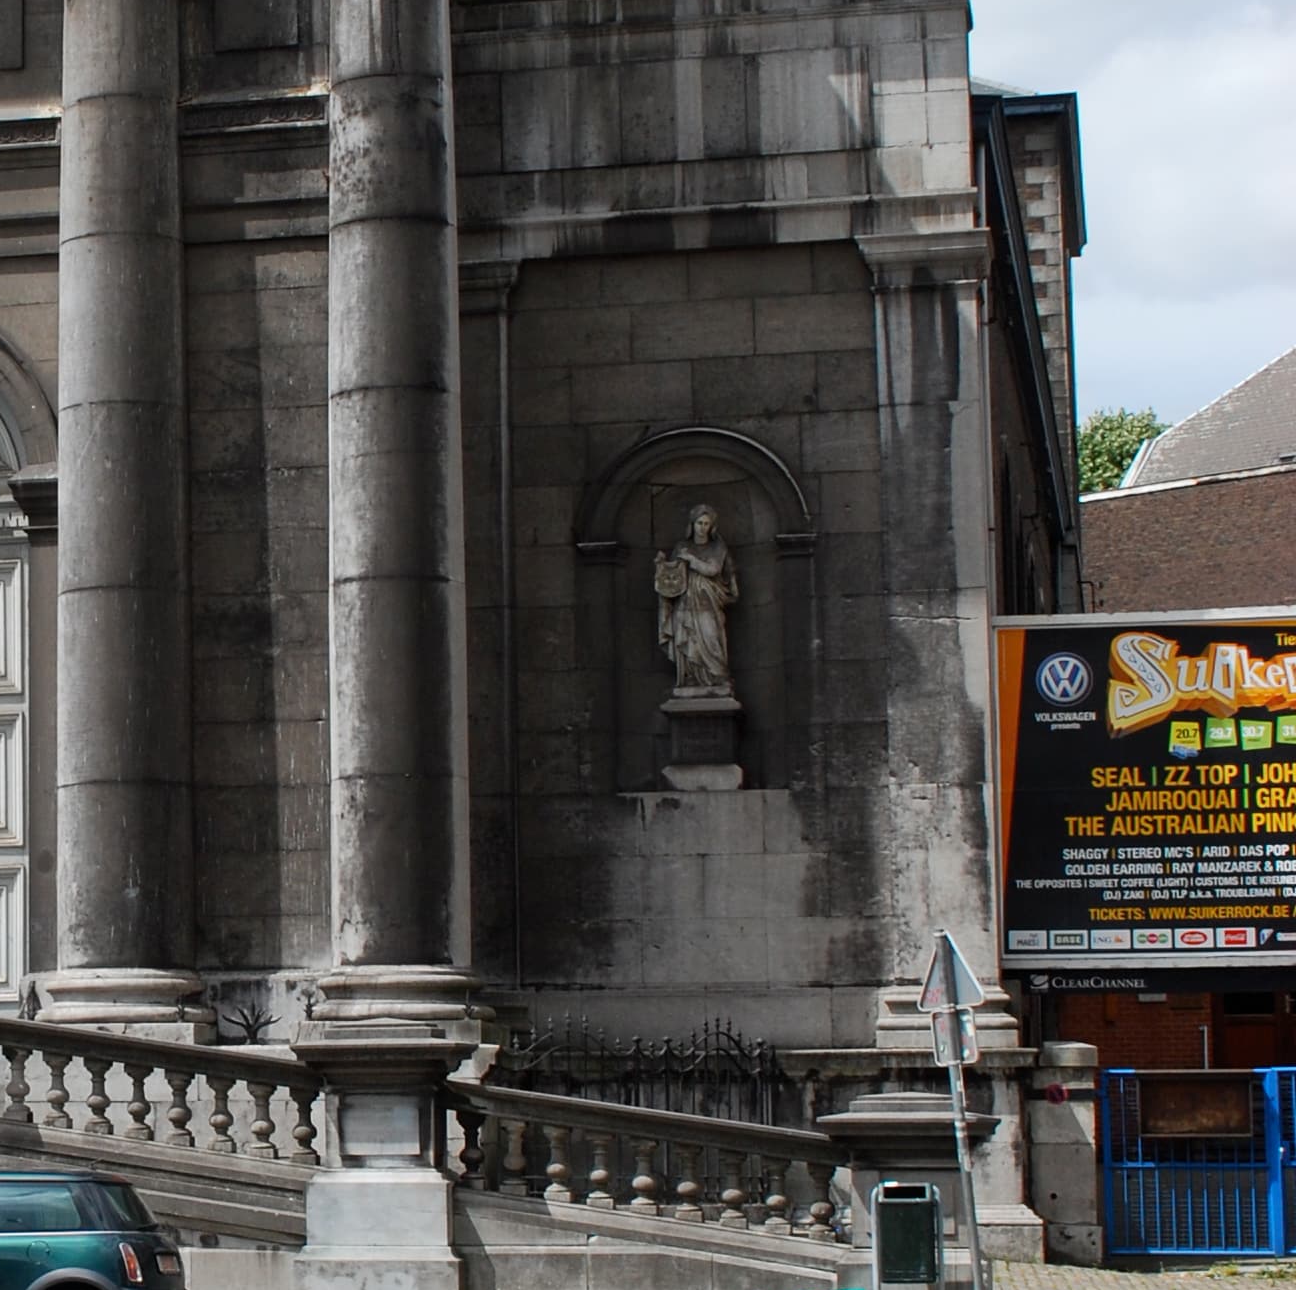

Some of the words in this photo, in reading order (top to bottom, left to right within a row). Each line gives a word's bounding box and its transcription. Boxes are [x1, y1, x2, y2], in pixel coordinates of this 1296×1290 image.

[1034, 711, 1096, 722] VOLKSWAGEN
[1175, 728, 1198, 739] 20.7
[1091, 767, 1146, 788] SEAL
[1164, 765, 1190, 786] ZZ
[1195, 764, 1239, 785] TOP
[1256, 763, 1296, 784] JOH
[1105, 789, 1237, 812] JAMIROQUAI
[1256, 787, 1296, 809] GRA
[1064, 816, 1106, 836] THE
[1110, 813, 1245, 836] AUSTRALIAN
[1251, 812, 1296, 833] PINK
[1062, 848, 1109, 860] SHAGGY
[1117, 847, 1162, 859] STEREO
[1164, 846, 1194, 858] MC'S
[1202, 845, 1231, 857] ARID
[1239, 845, 1264, 857] DAS
[1265, 844, 1290, 857] POP
[1064, 864, 1110, 876] GOLDEN
[1112, 863, 1164, 875] EARRING
[1172, 862, 1195, 874] RAY
[1197, 861, 1262, 873] MANZAREK
[1264, 861, 1274, 873] &
[1015, 879, 1033, 889] THE
[1034, 879, 1082, 889] OPPOSITES
[1088, 878, 1119, 888] SWEET
[1120, 878, 1154, 888] COFFEE
[1194, 876, 1239, 886] CUSTOMS
[1088, 907, 1146, 921] TICKETS:
[1148, 905, 1290, 920] WWW.SUIKERROCK.BE
